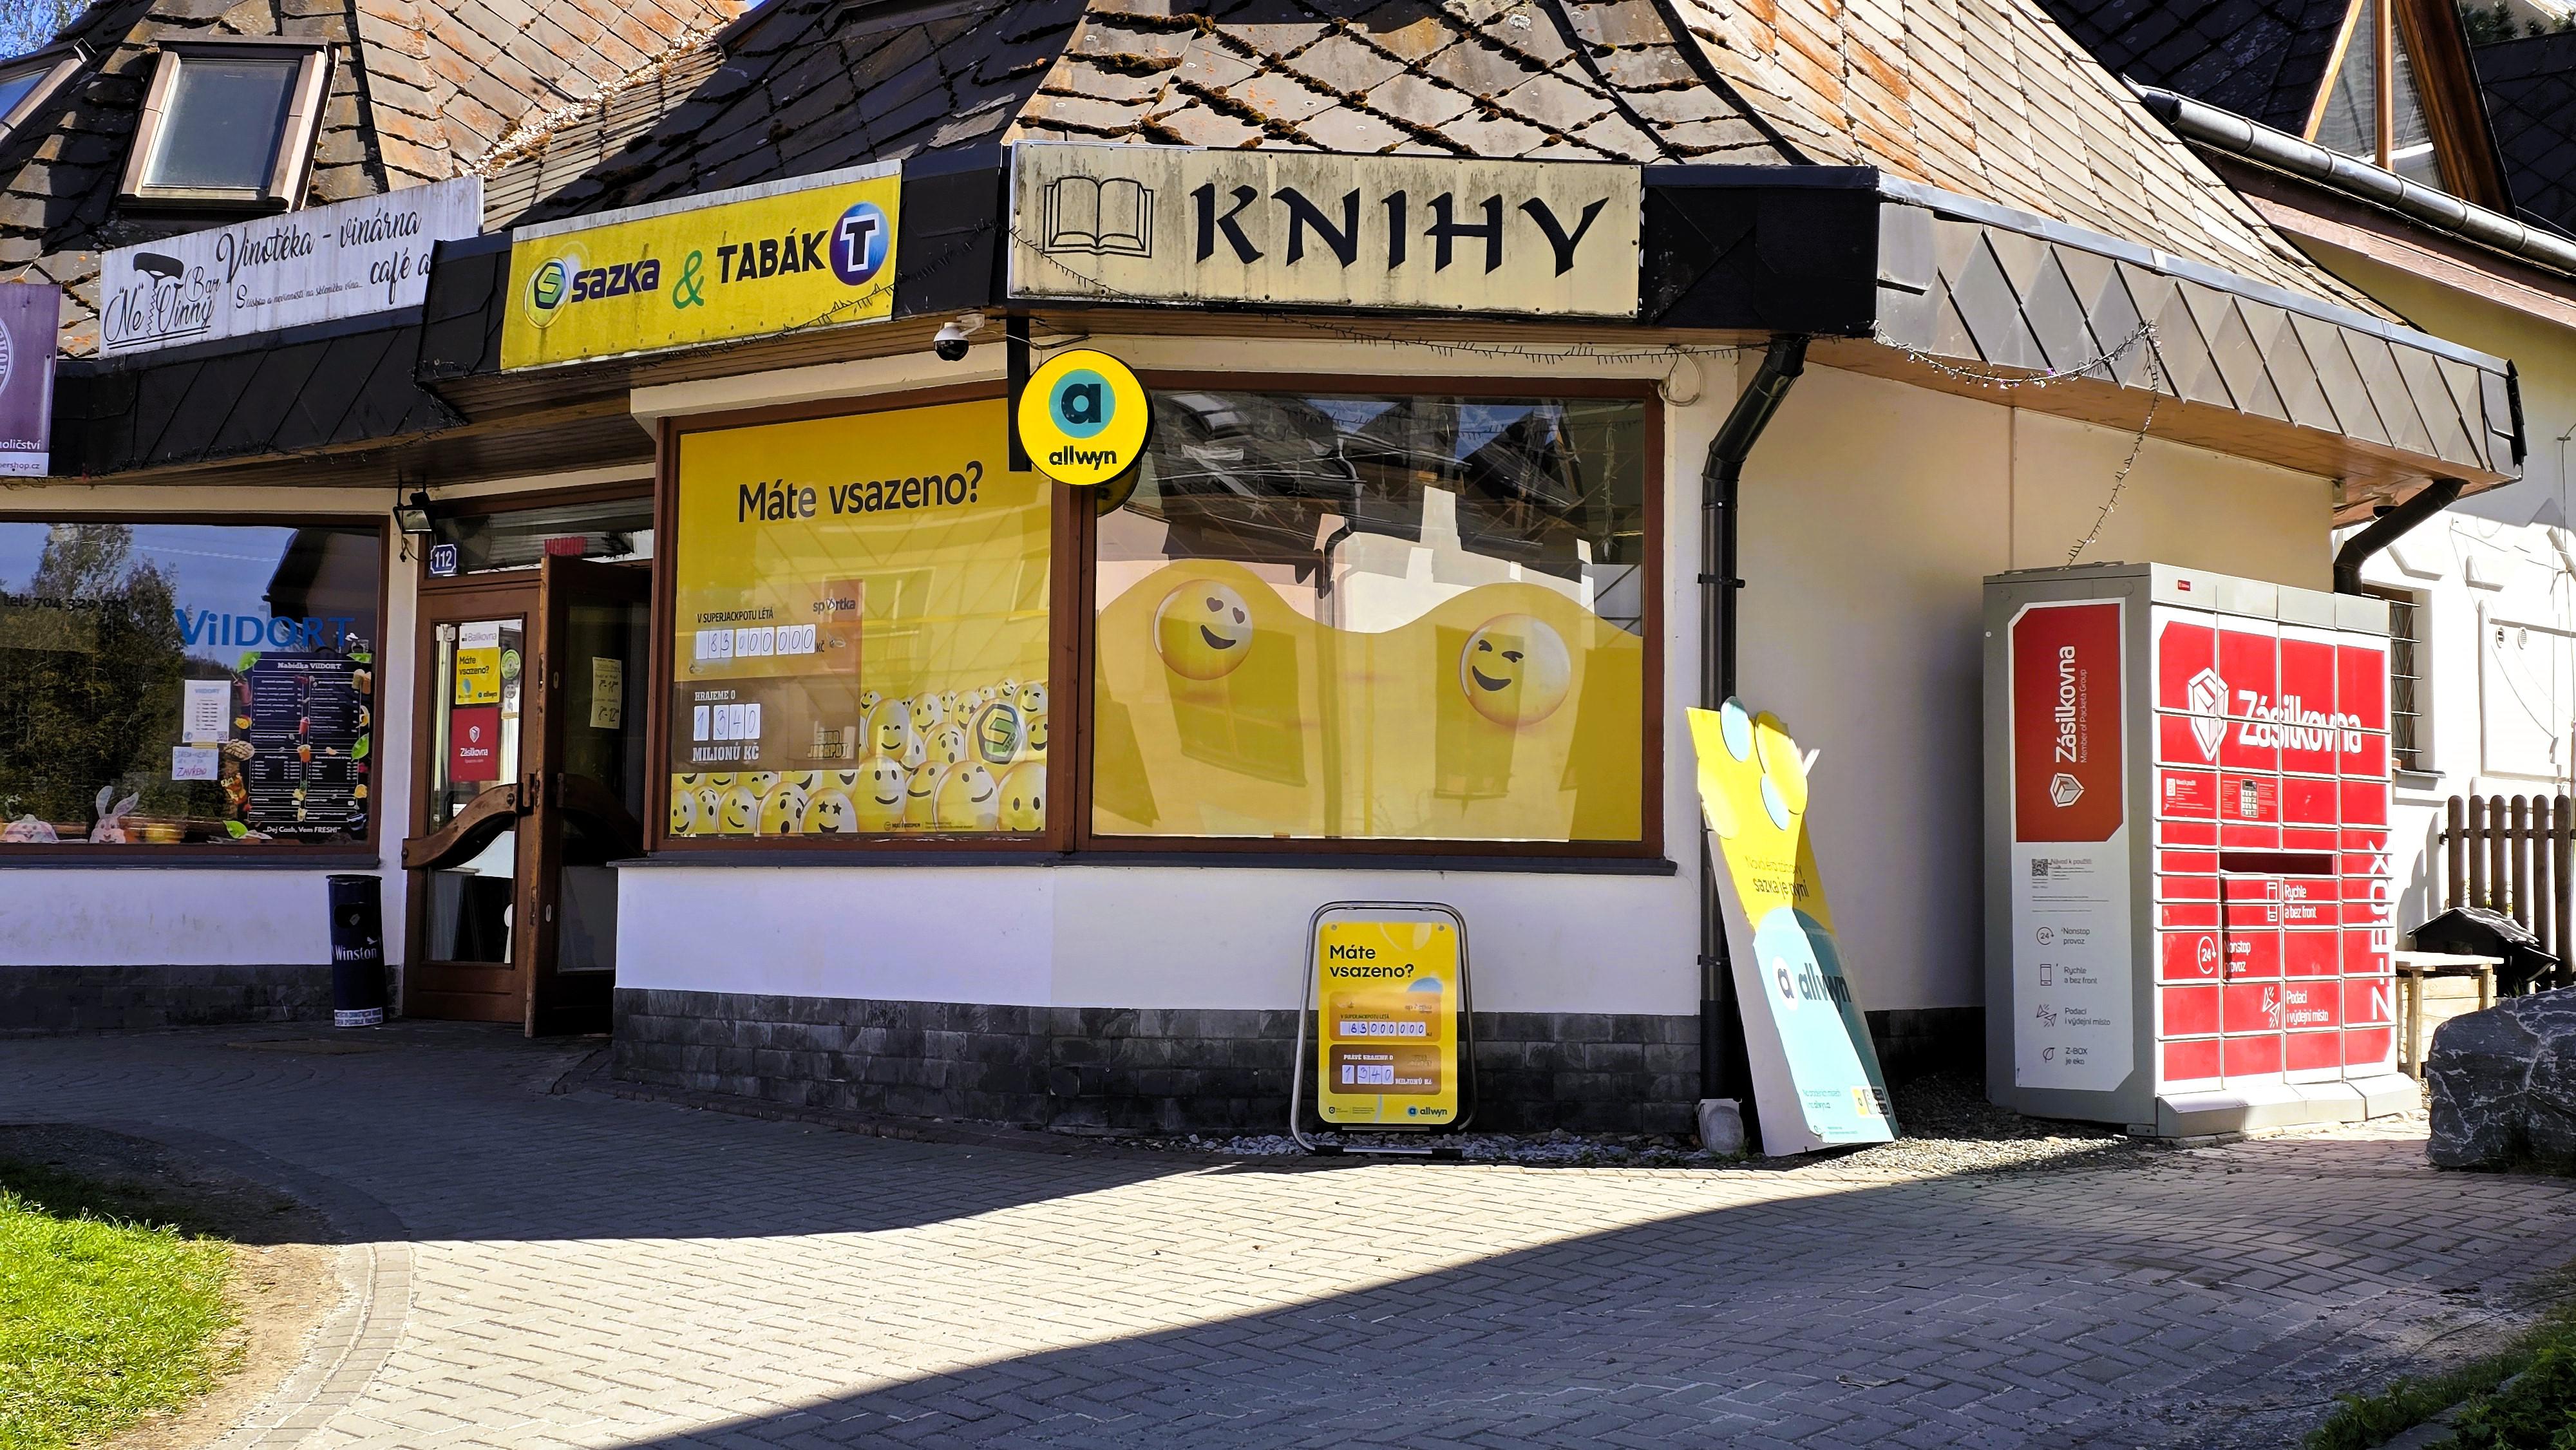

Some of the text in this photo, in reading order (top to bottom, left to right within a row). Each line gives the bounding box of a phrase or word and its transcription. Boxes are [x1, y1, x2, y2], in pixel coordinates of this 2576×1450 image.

[1190, 184, 1609, 278] KNIHY
[216, 224, 316, 283] Vinotéka
[340, 207, 422, 248] vinárna
[370, 247, 412, 305] café
[673, 250, 705, 309] &
[717, 227, 828, 284] TABÁK
[185, 266, 221, 302] Bar
[0, 462, 40, 470] ershop.cz
[1048, 446, 1117, 471] allwyn
[739, 460, 984, 522] Máte vsazeno?
[435, 551, 452, 567] 112
[33, 597, 62, 611] 704
[697, 607, 773, 623] V SUPERJACKPOTU LÉTÁ
[174, 609, 355, 648] VilDORT
[711, 634, 729, 652] 83
[459, 656, 476, 665] Máte
[459, 666, 489, 675] vsazeno?
[695, 690, 735, 701] HRAJEME O
[2056, 646, 2076, 763] Zásilkovna
[716, 710, 756, 735] 340
[2080, 723, 2087, 731] of
[2239, 690, 2362, 753] Zásilkovna
[460, 748, 488, 757] Zásilkovna
[693, 741, 759, 762] MILIONŮ KČ
[1753, 878, 1779, 893] sazka
[1777, 876, 1788, 900] je
[2284, 884, 2307, 901] Rychle
[2284, 905, 2317, 918] a bez front
[2369, 840, 2389, 1021] Z-BOX
[335, 945, 377, 961] Winston
[2202, 941, 2251, 962] 24 Nonstop
[1330, 945, 1414, 978] Máte vsazeno?
[1799, 963, 1852, 1015] allwyn
[2286, 990, 2307, 1004] Podací
[2068, 1016, 2091, 1026] výdejní
[2093, 1017, 2110, 1026] místo
[2289, 1009, 2312, 1026] výdejní
[2312, 1009, 2329, 1022] místo
[1370, 1023, 1394, 1034] 000
[1400, 1024, 1424, 1034] 000
[1359, 1067, 1391, 1082] 340
[1420, 1107, 1447, 1117] allwyn
